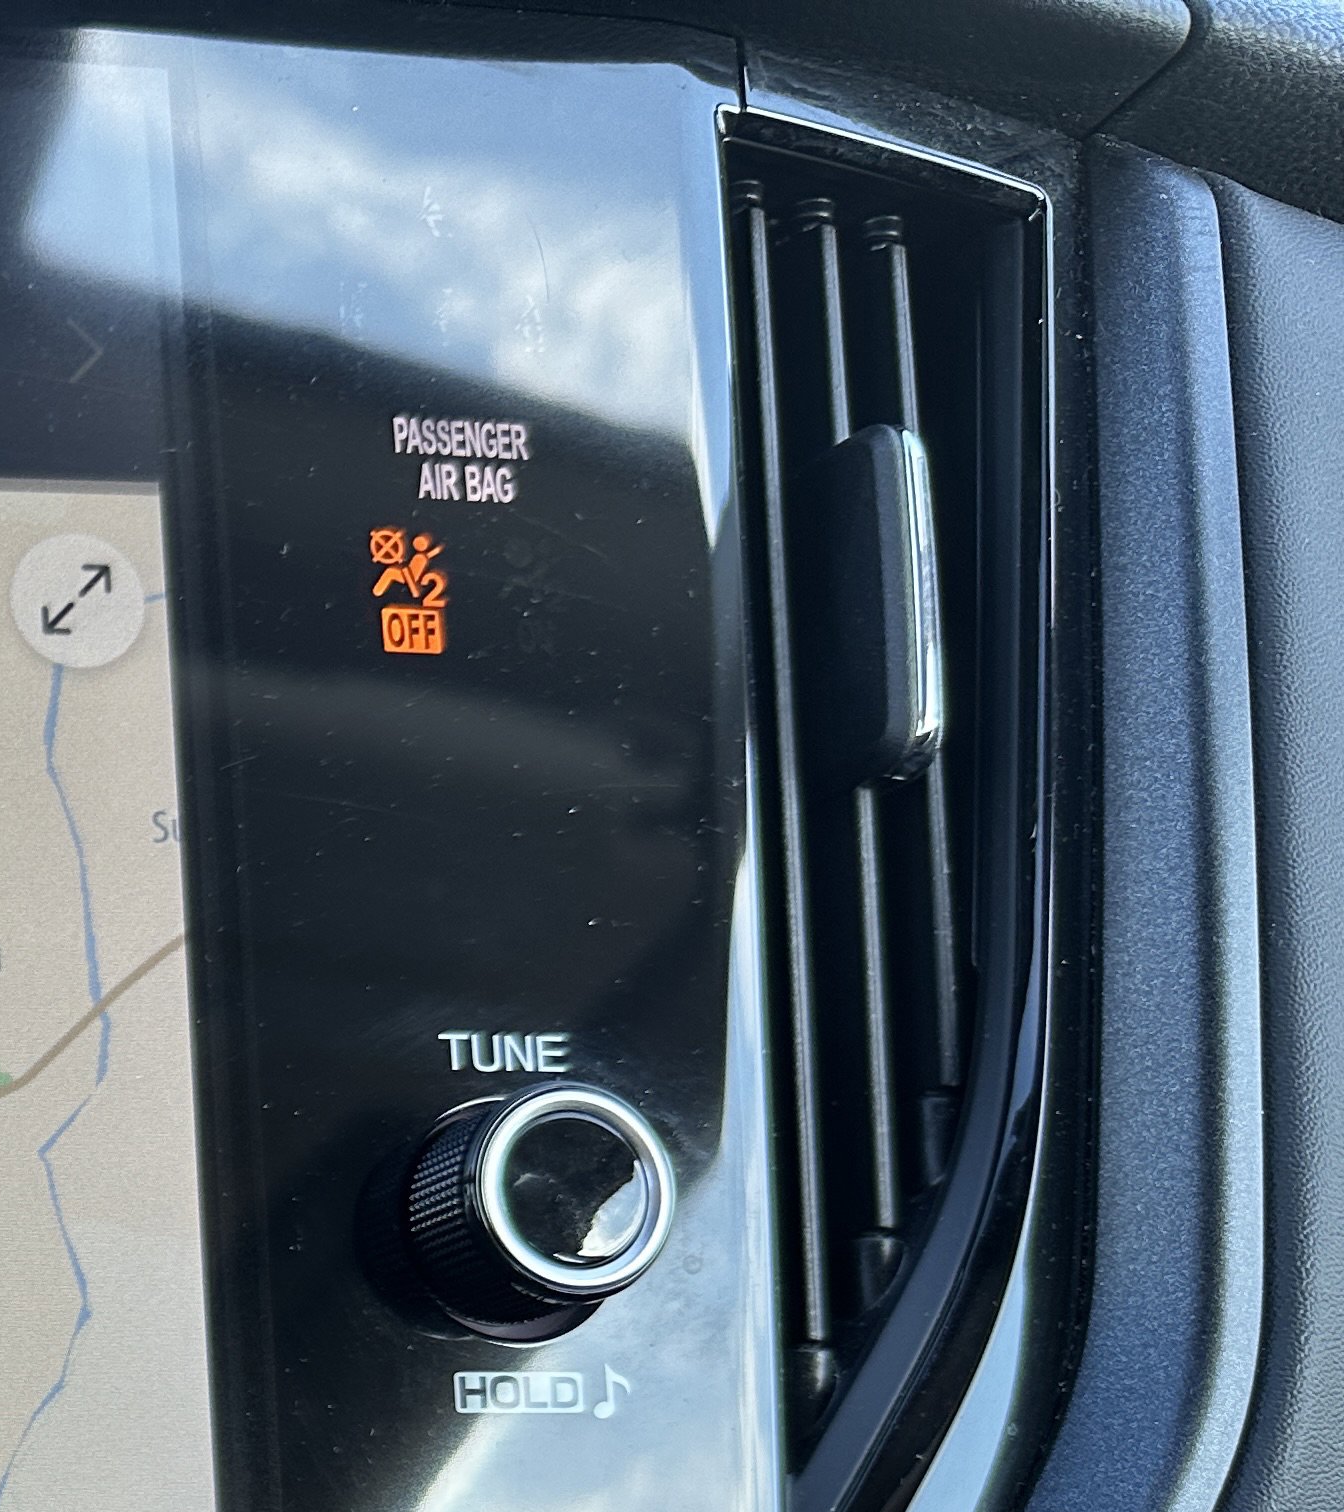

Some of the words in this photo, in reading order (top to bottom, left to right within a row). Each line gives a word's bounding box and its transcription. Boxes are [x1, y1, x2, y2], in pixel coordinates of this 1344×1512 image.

[393, 416, 530, 460] PASSENGER
[418, 463, 459, 500] AIR
[465, 467, 514, 504] BAG
[387, 614, 440, 649] OFF
[438, 1031, 570, 1074] TUNE
[459, 1375, 580, 1410] HOLD
